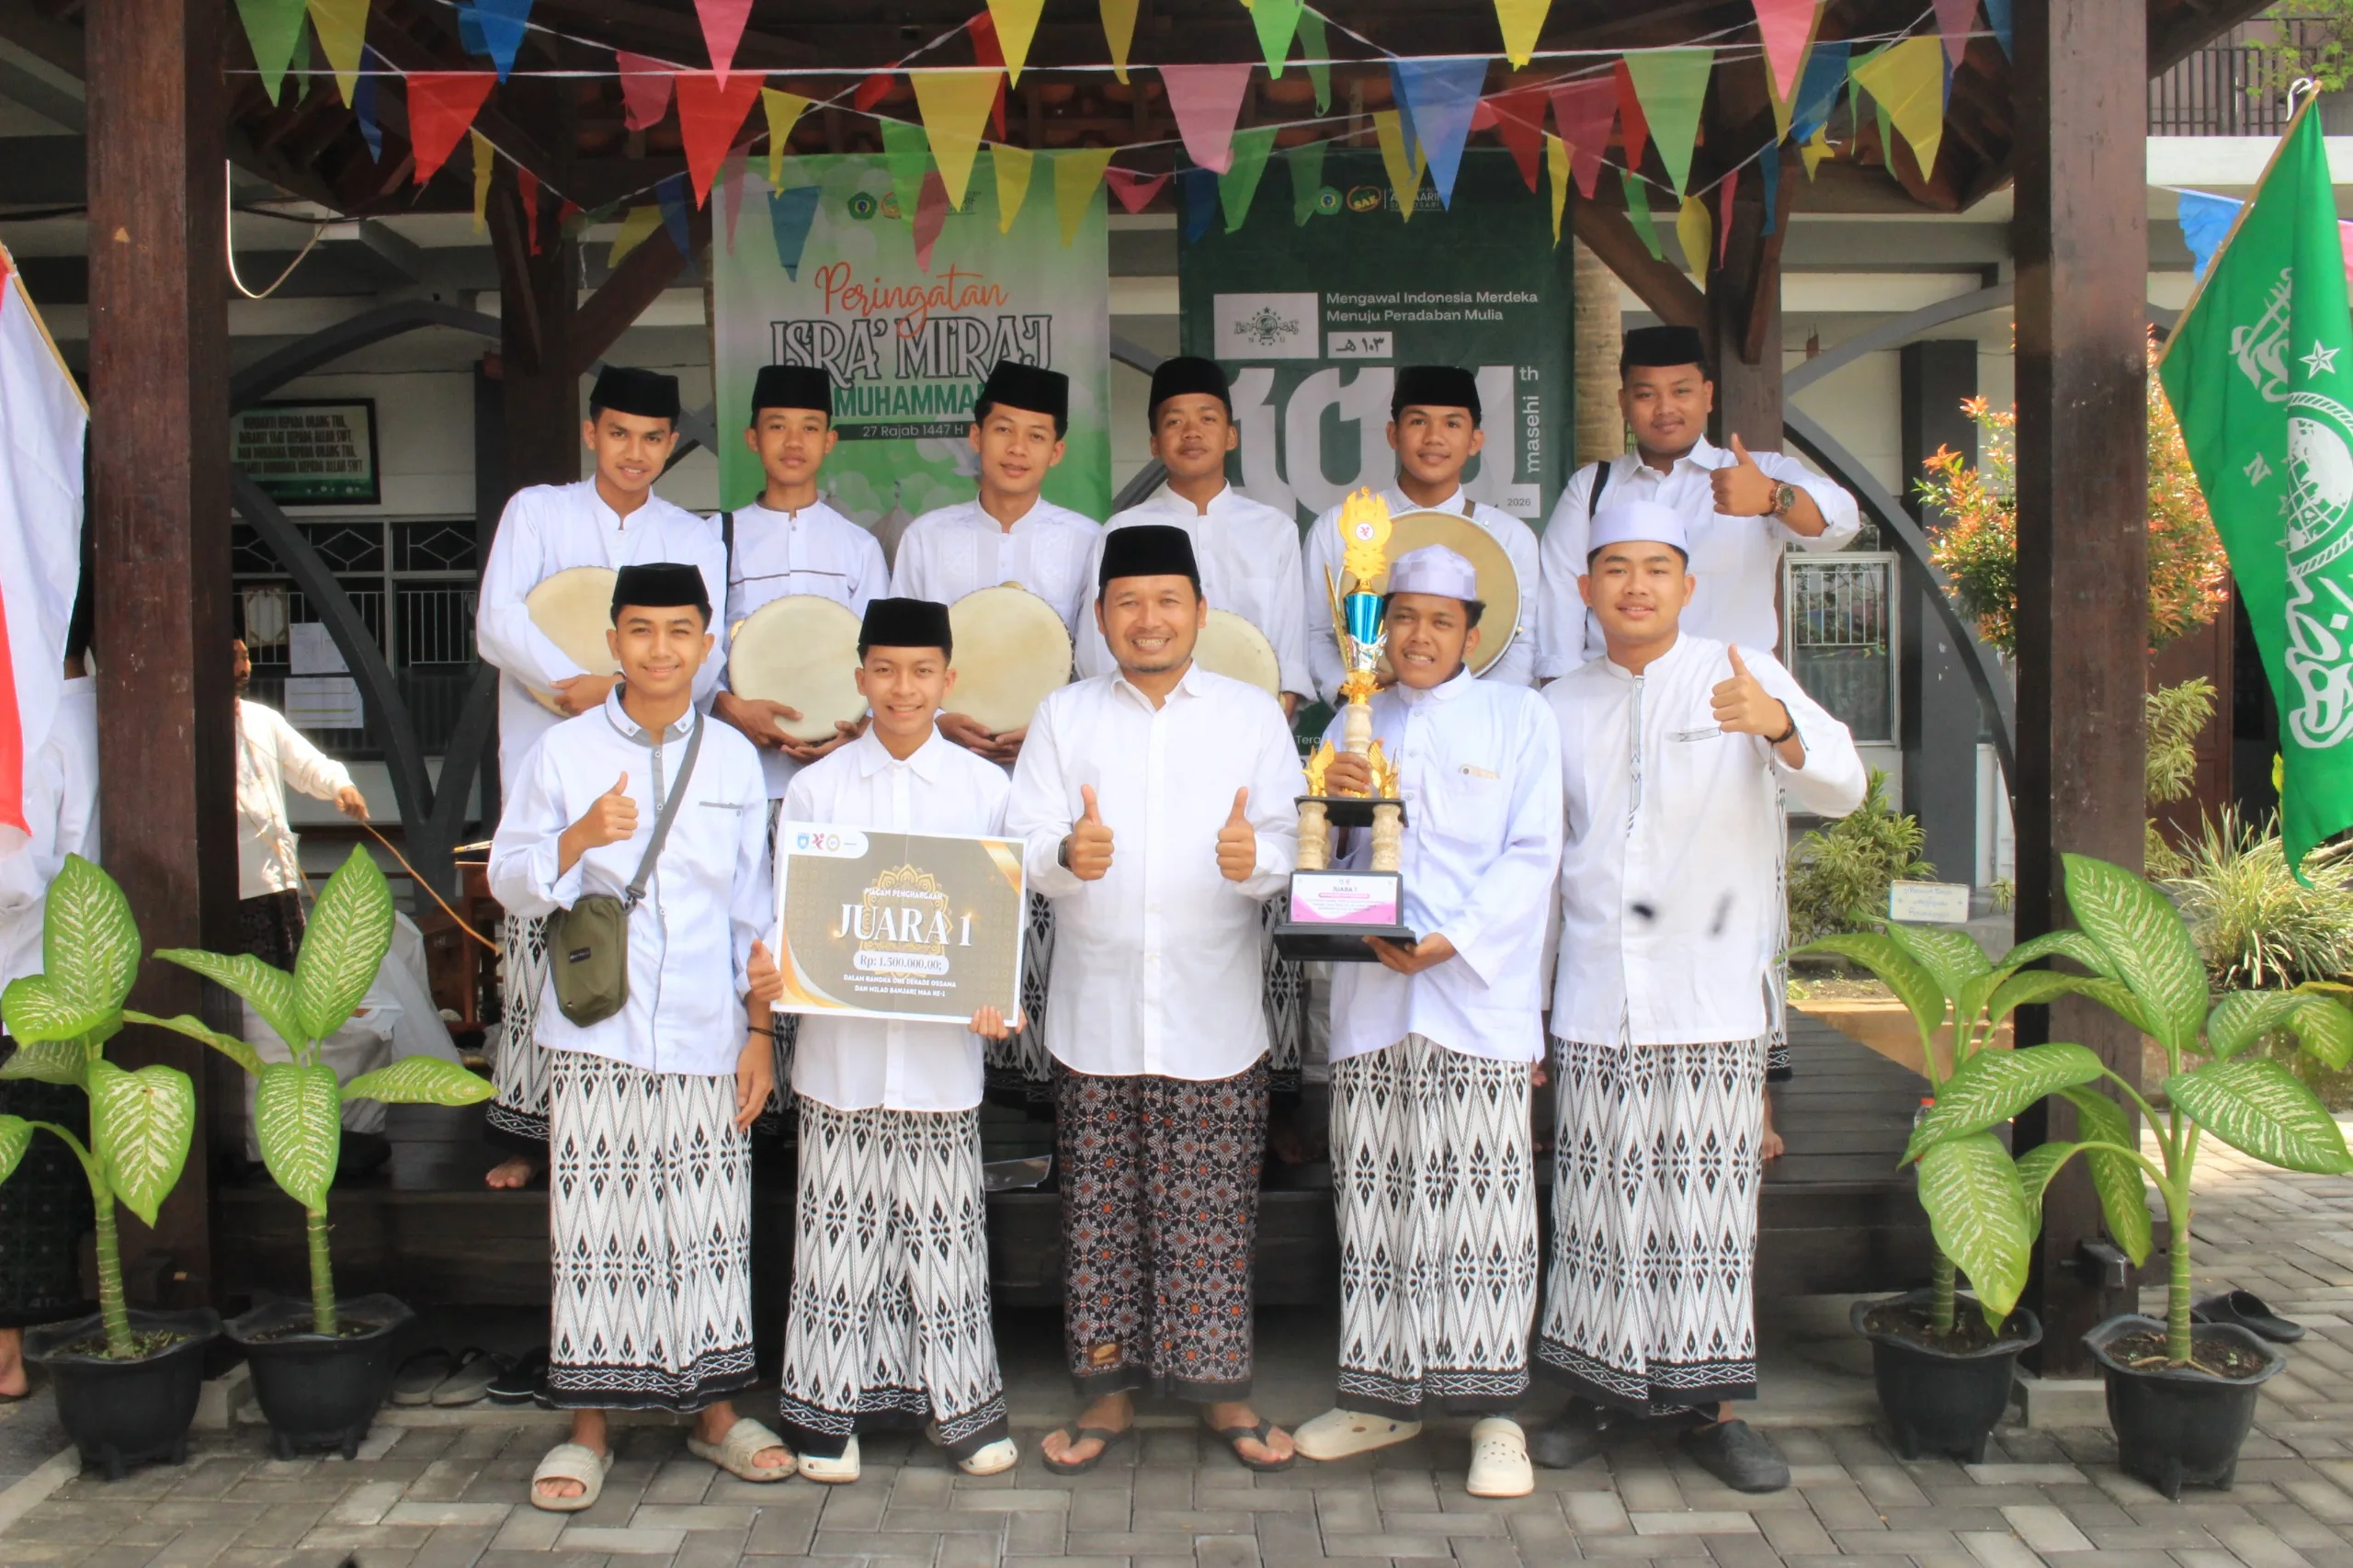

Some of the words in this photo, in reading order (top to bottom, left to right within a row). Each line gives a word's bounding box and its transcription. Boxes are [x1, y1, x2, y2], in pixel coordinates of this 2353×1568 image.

[814, 261, 1009, 339] Peringatan
[1326, 292, 1400, 307] Mengawal
[1404, 291, 1473, 304] Indonesia
[1476, 290, 1539, 303] Merdeka
[1326, 310, 1380, 324] Menuju
[1383, 309, 1461, 322] Peradaban
[1464, 308, 1504, 321] Mulia
[1519, 366, 1539, 381] th
[862, 426, 878, 437] 27
[881, 425, 920, 439] Rajab
[922, 424, 951, 436] 1447
[954, 424, 963, 435] H
[1522, 395, 1540, 474] masehi
[1507, 498, 1532, 507] 2026
[864, 887, 891, 897] PIAGAM
[892, 889, 943, 900] PENGHARGAAN
[833, 903, 949, 946] JUARA
[958, 912, 972, 948] 1
